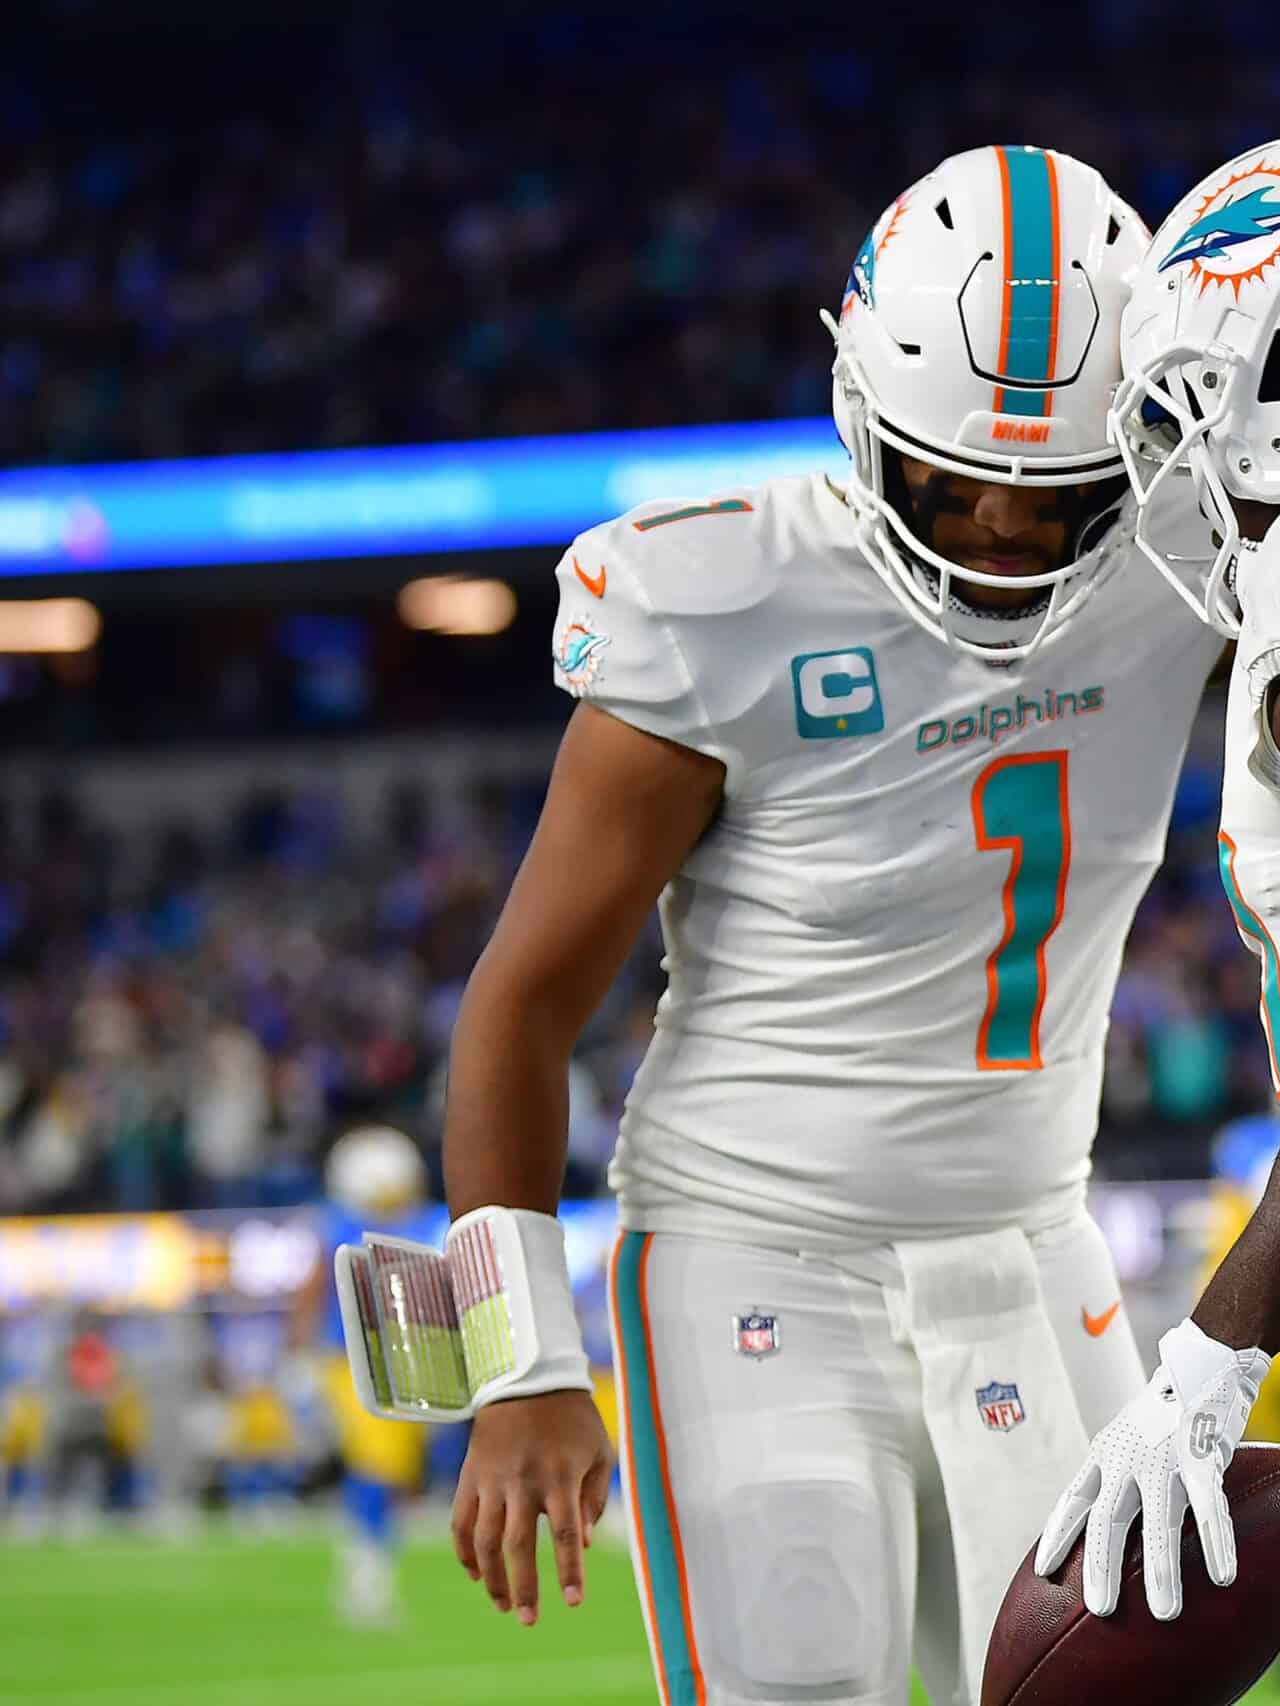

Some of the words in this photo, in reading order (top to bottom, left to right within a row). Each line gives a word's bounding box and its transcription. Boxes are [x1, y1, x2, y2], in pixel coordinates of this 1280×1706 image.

[991, 419, 1051, 443] MIAMI
[801, 652, 874, 719] C
[916, 686, 1105, 754] Dolphins
[971, 750, 1071, 1071] 1
[982, 1402, 1022, 1427] NFL
